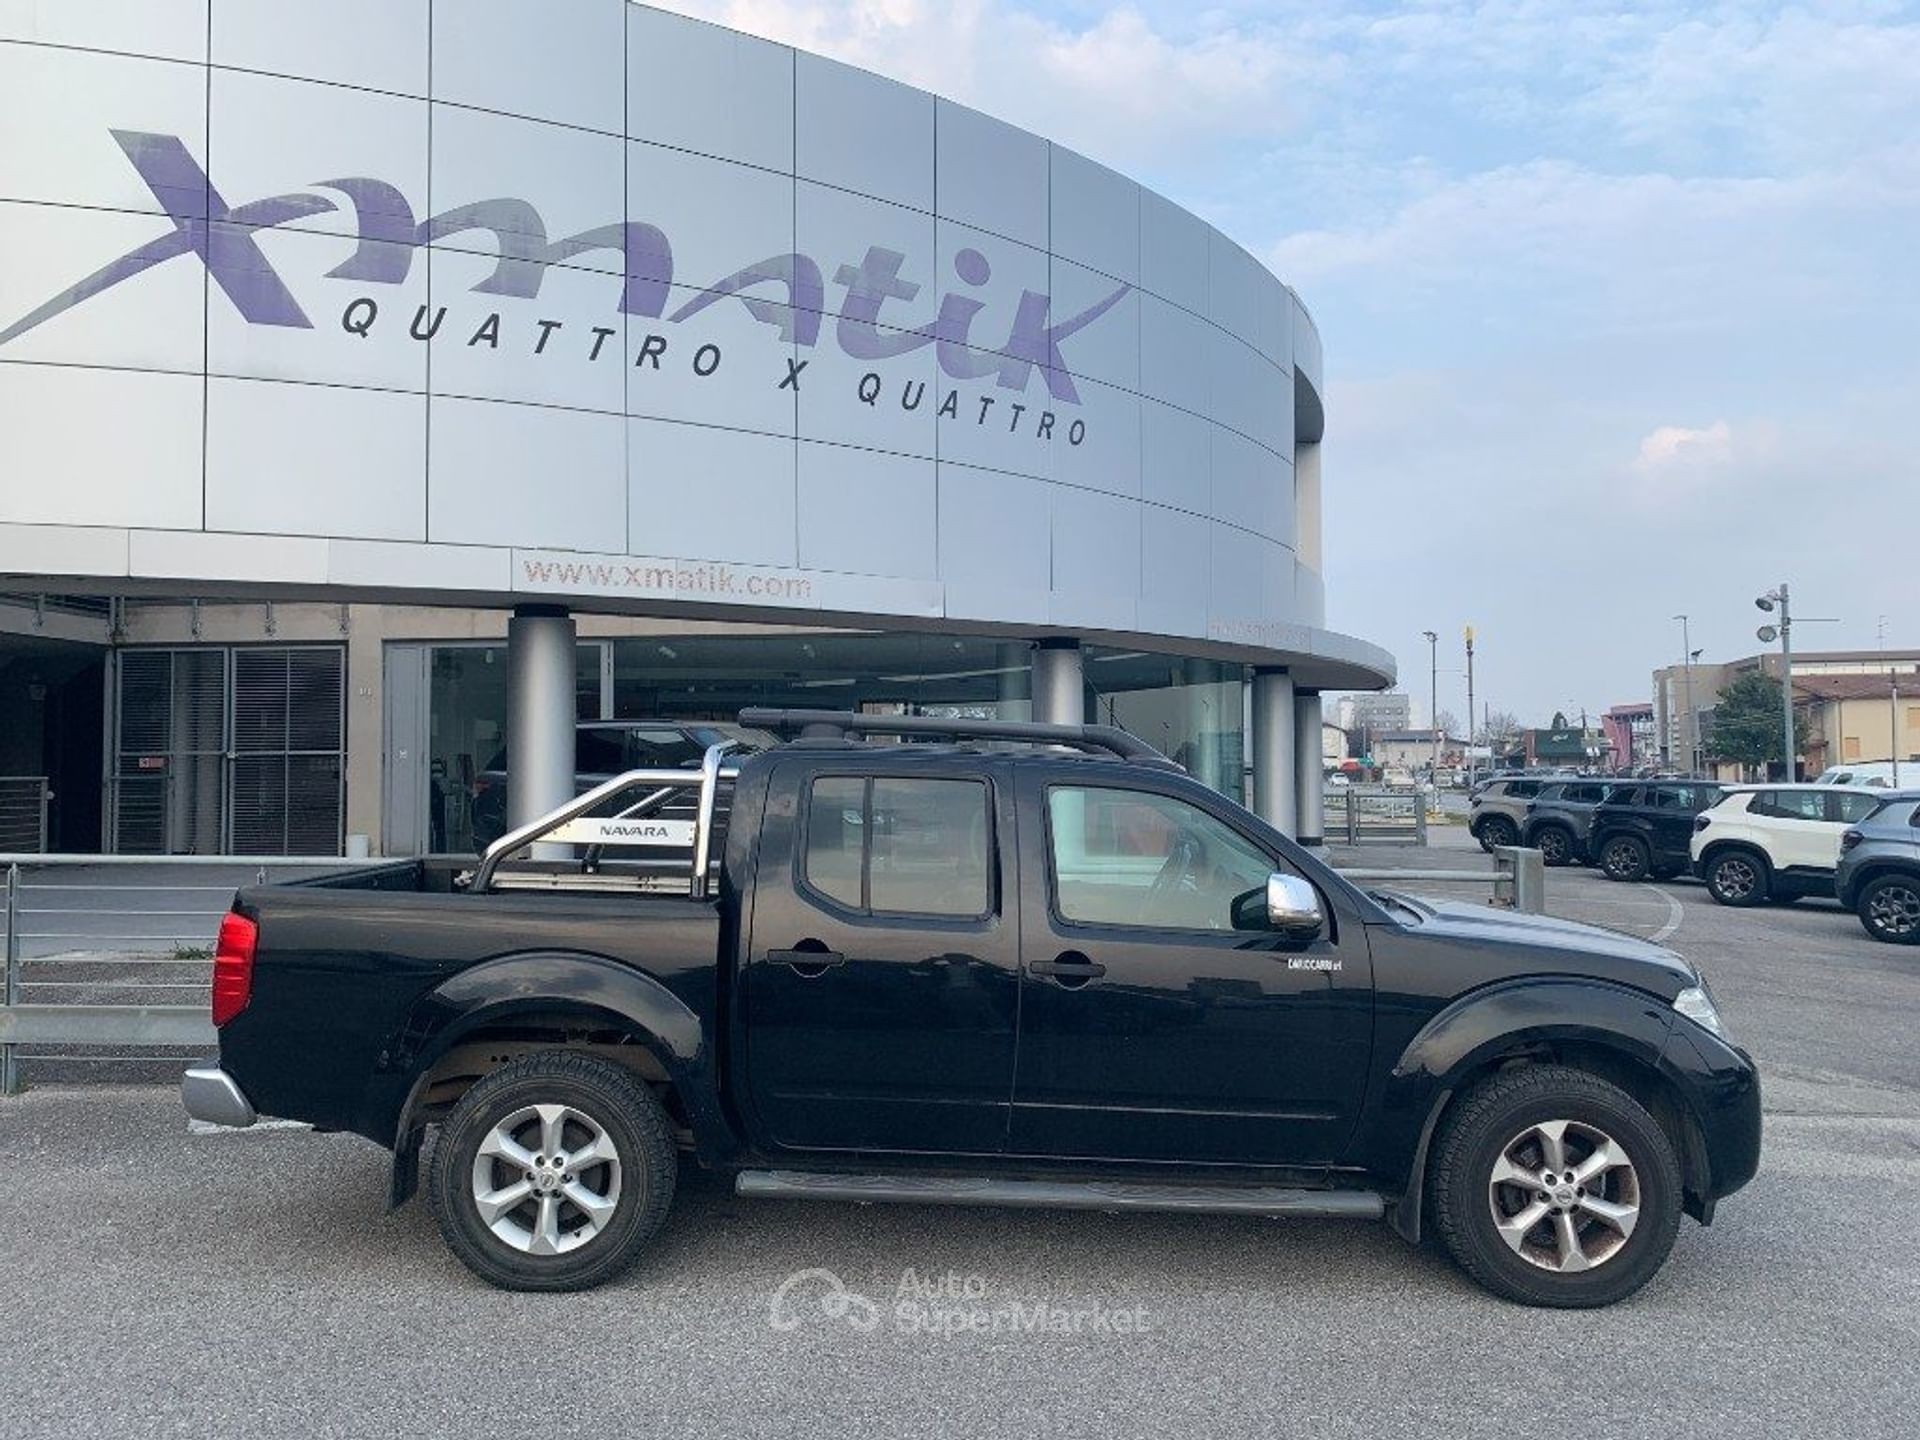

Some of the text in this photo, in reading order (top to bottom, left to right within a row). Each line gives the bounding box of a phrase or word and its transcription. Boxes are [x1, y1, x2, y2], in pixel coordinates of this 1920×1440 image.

[342, 297, 1086, 446] QUATTRO X QUATTRO
[524, 560, 811, 598] www.xmatik.com
[600, 826, 668, 837] NAVARA
